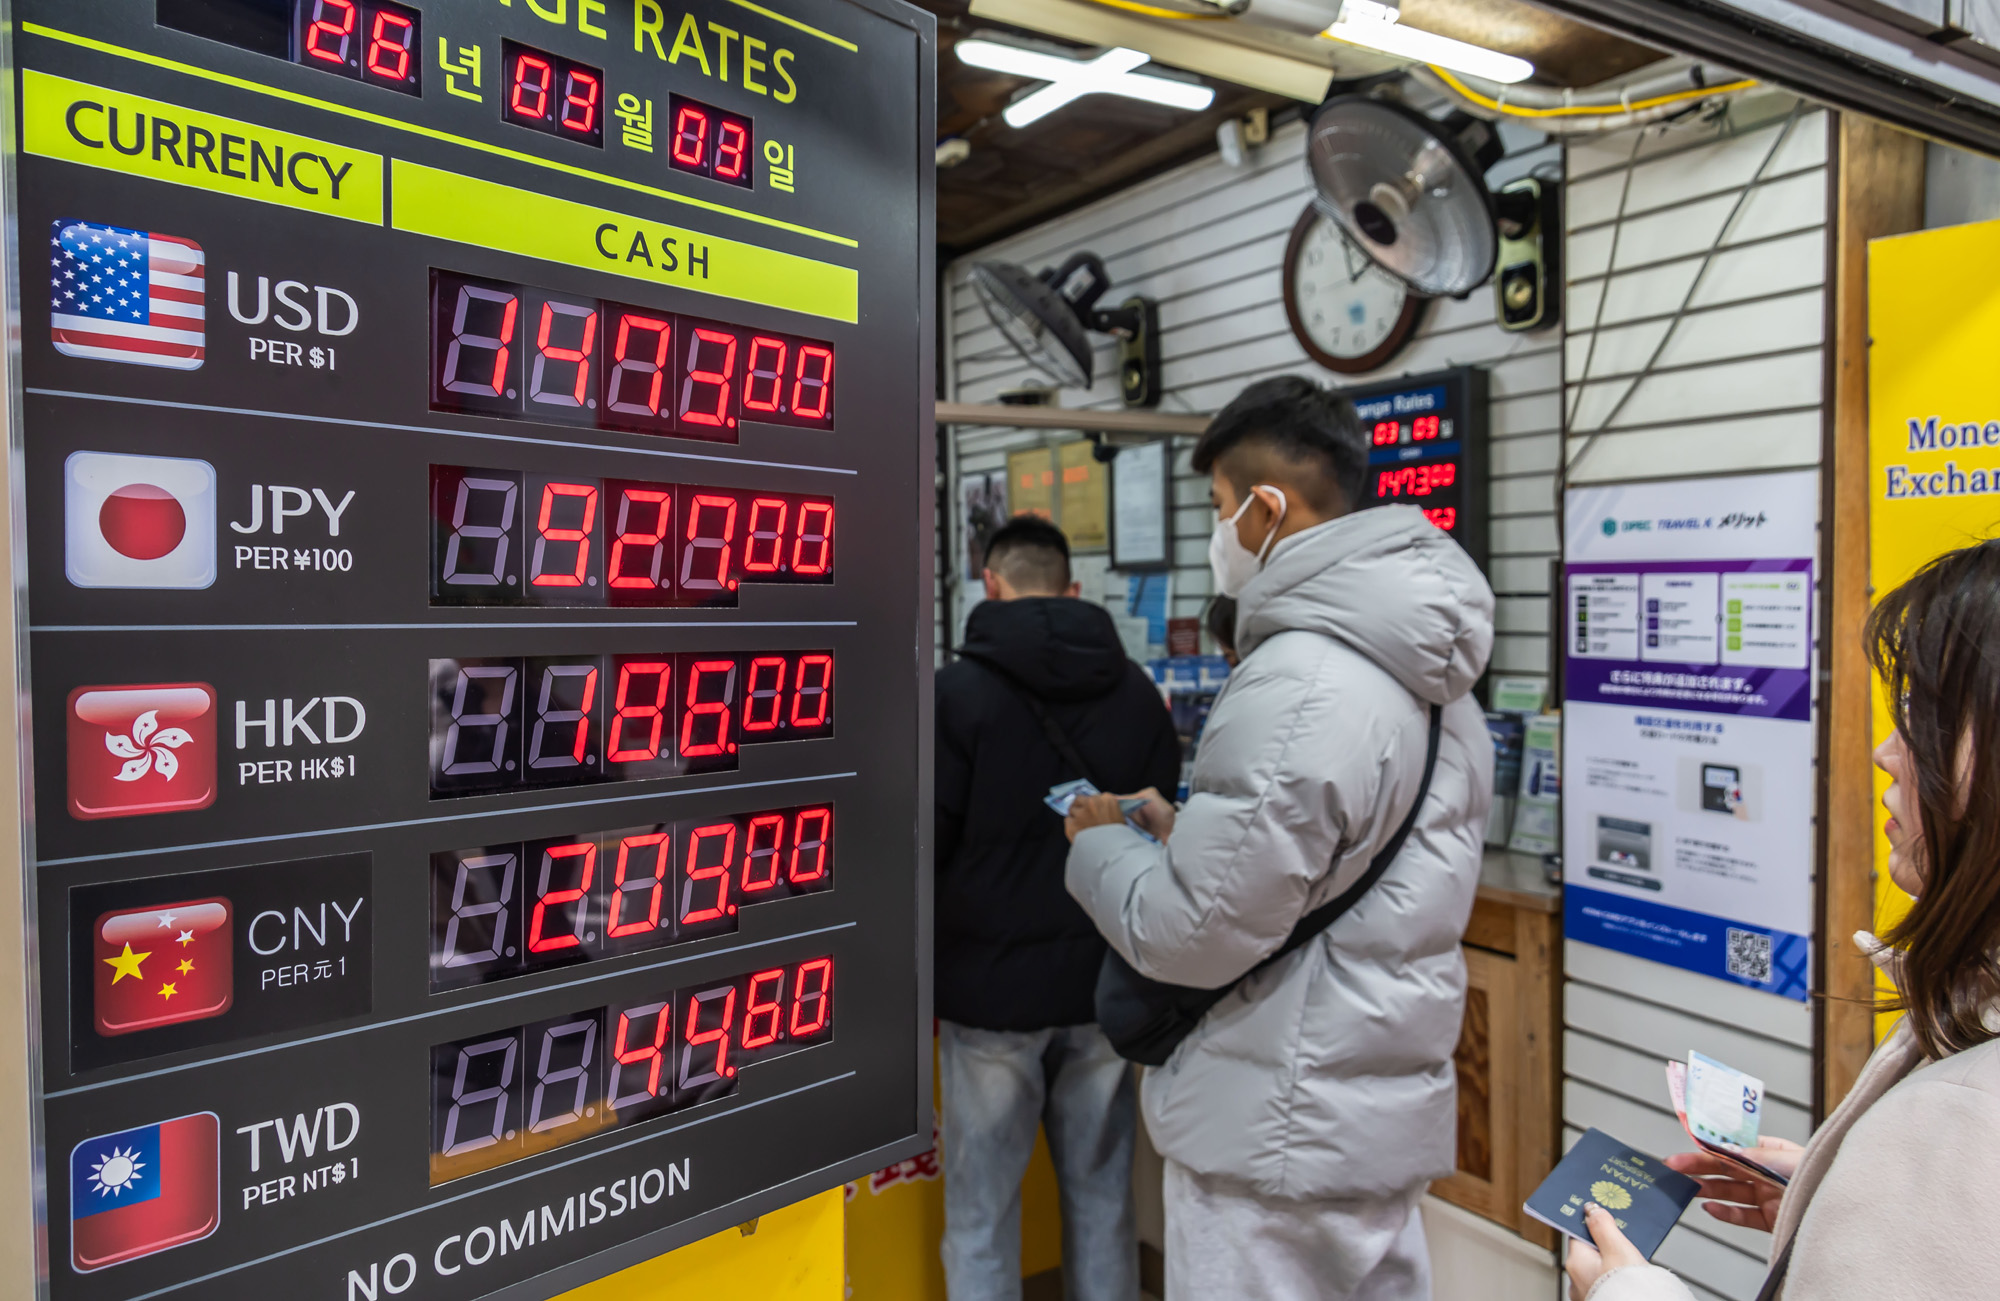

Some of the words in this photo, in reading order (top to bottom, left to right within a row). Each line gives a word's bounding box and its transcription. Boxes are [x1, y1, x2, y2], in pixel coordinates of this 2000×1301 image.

[634, 0, 797, 104] RATES
[306, 0, 411, 81] 26
[439, 36, 483, 103] 년
[511, 54, 598, 133] 03
[614, 93, 654, 153] 월
[673, 107, 746, 178] 03
[763, 139, 794, 193] 일
[65, 100, 353, 200] CURRENCY
[595, 223, 709, 279] CASH
[227, 271, 359, 336] USD
[248, 337, 303, 367] PER
[309, 346, 336, 371] $1
[230, 484, 356, 537] JPY
[234, 545, 289, 570] PER
[293, 548, 353, 572] ¥100
[235, 696, 367, 750] HKD
[239, 760, 293, 785] PER
[301, 754, 355, 781] HK$1
[248, 897, 364, 956] CNY
[262, 968, 309, 991] PER
[1743, 1085, 1758, 1114] 20
[236, 1102, 360, 1173] TWD
[242, 1175, 296, 1210] PER
[303, 1157, 358, 1193] NT$1
[1600, 1163, 1651, 1191] JAPAN
[1607, 1155, 1656, 1185] PASSPORT
[347, 1252, 417, 1301] NO
[433, 1157, 691, 1276] COMMISSION
